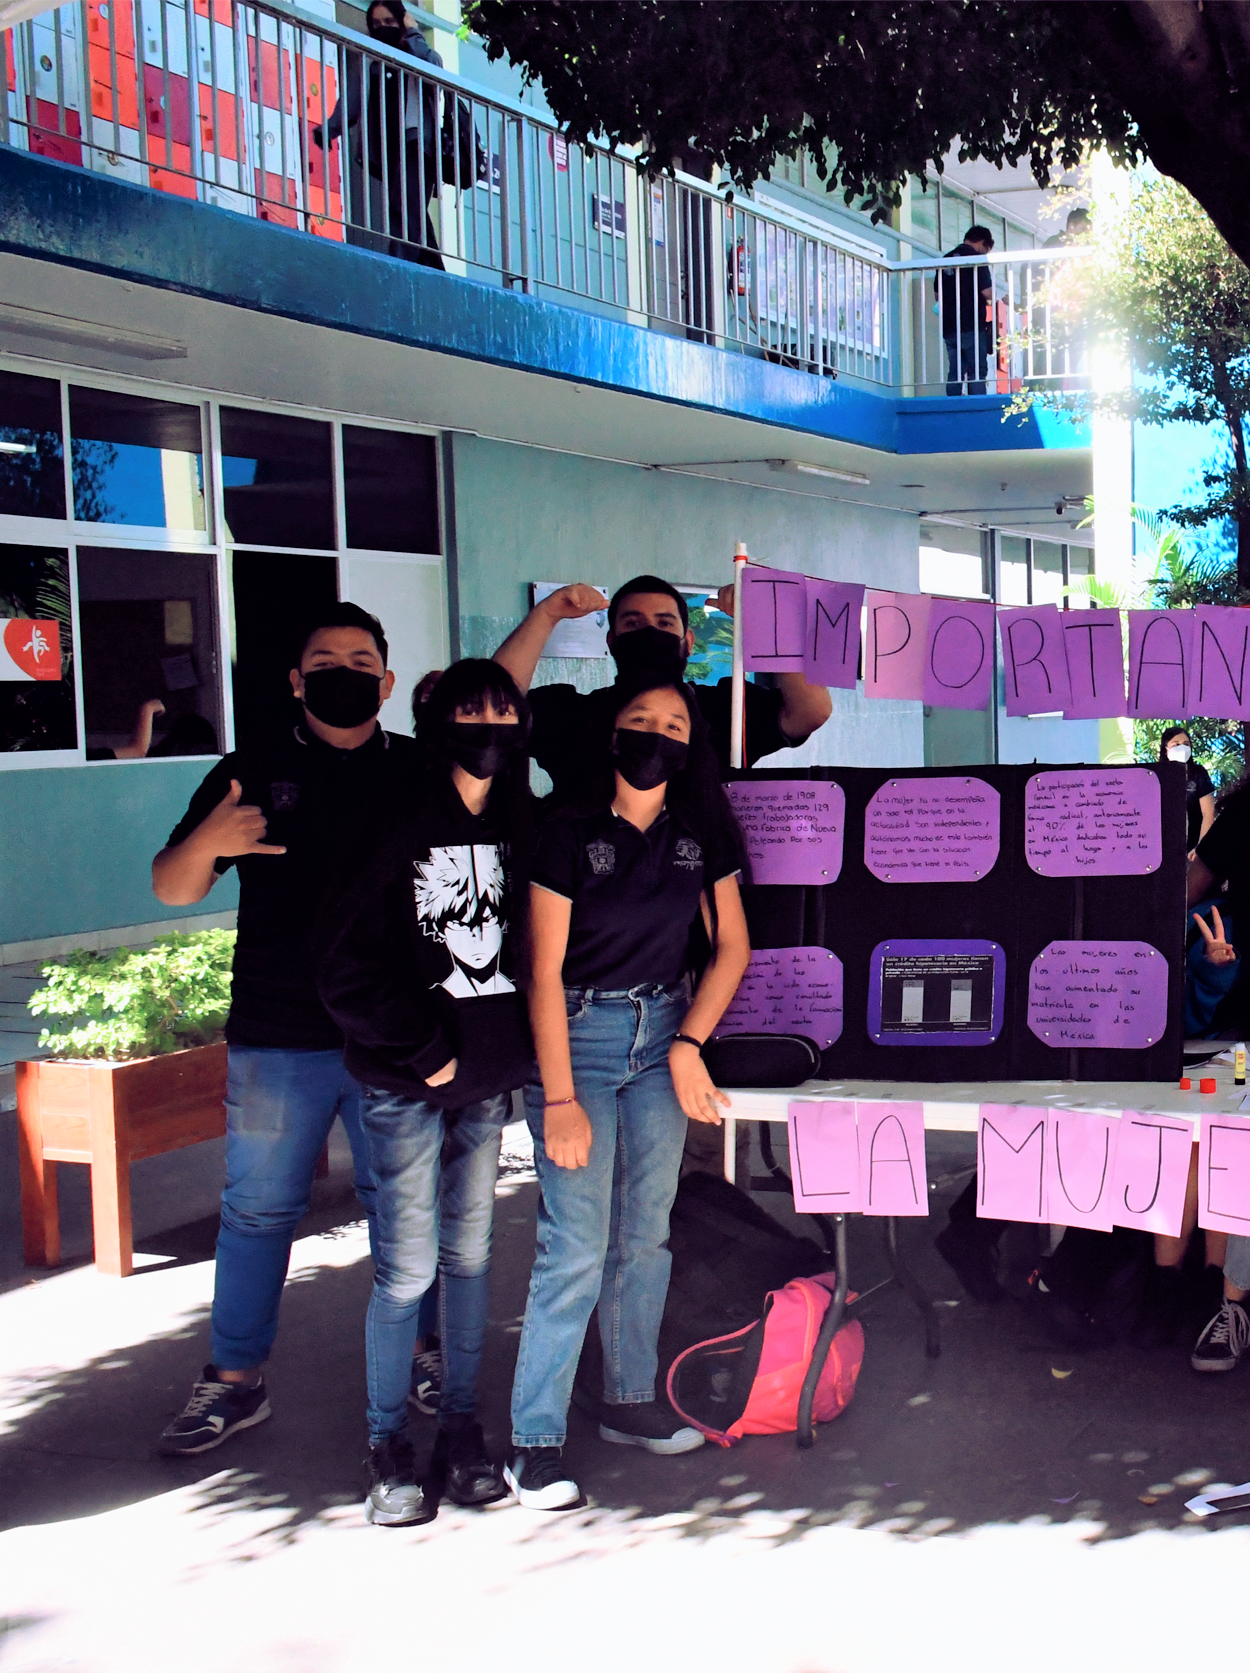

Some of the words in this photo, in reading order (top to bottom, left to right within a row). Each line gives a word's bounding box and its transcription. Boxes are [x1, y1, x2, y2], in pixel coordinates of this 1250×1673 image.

[797, 791, 816, 799] 1908
[1035, 966, 1049, 974] los
[1115, 967, 1138, 976] años
[1034, 983, 1051, 991] han
[1065, 983, 1118, 993] aumentado
[1113, 1015, 1130, 1024] de
[793, 1114, 919, 1206] LA
